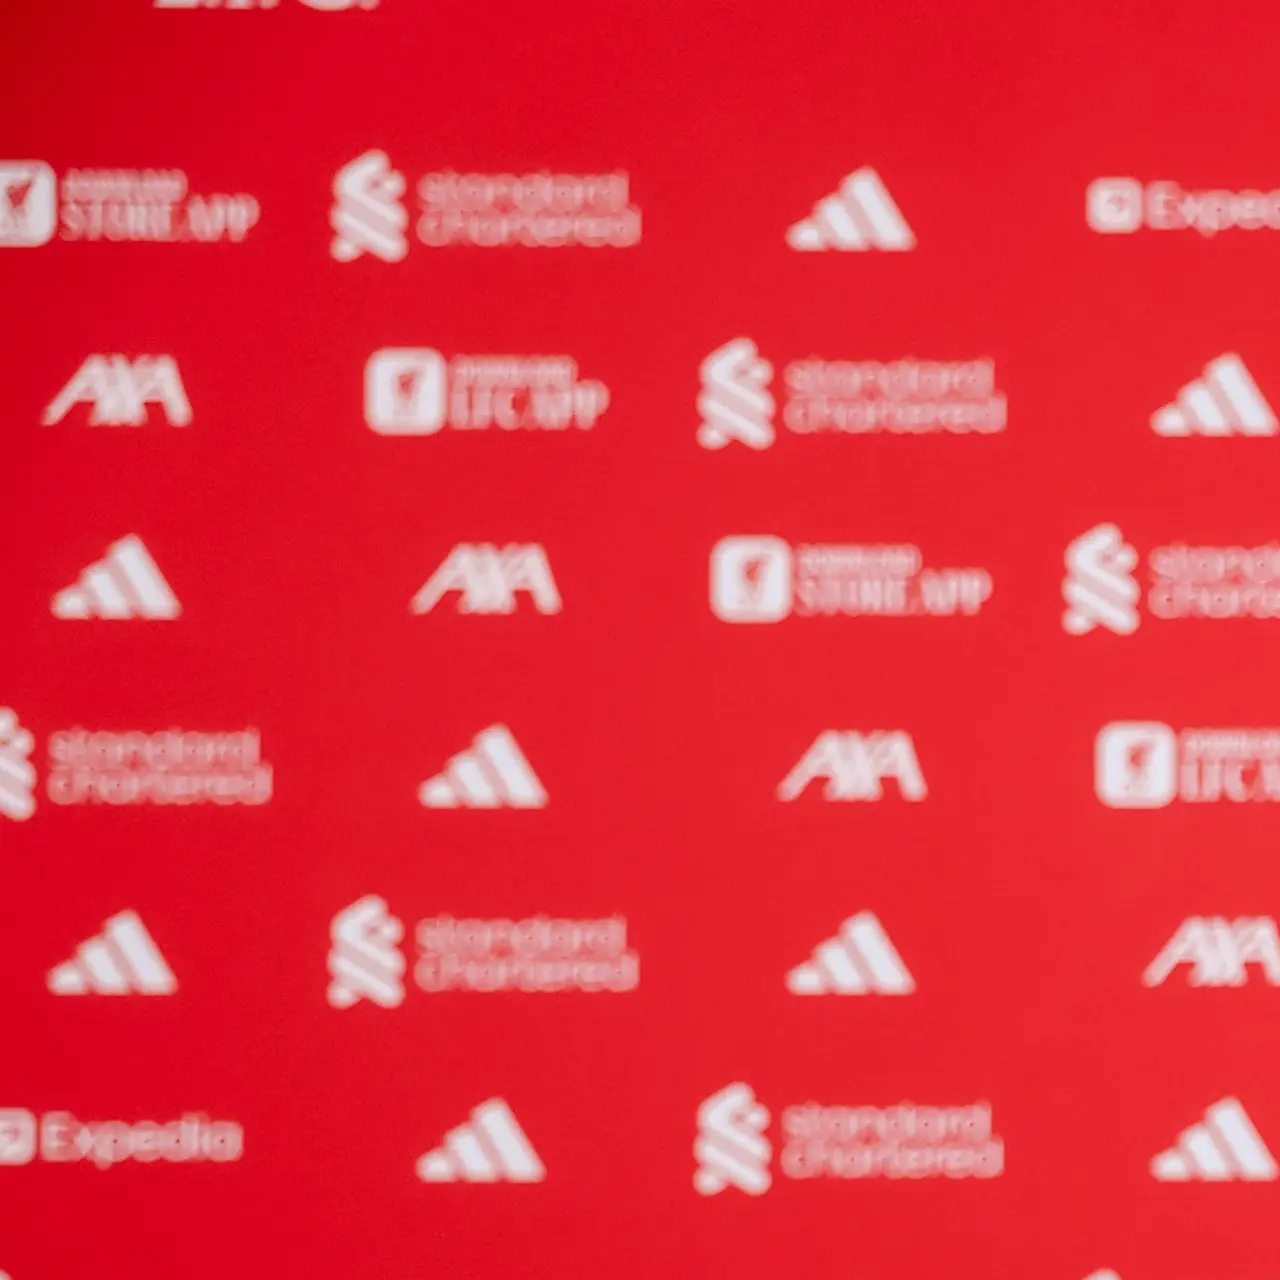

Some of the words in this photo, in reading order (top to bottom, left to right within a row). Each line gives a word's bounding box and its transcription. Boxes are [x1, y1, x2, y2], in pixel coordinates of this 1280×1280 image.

[41, 353, 193, 427] AXA
[411, 542, 562, 615] AXA
[778, 730, 927, 802] AXA
[38, 1111, 244, 1169] Expedia
